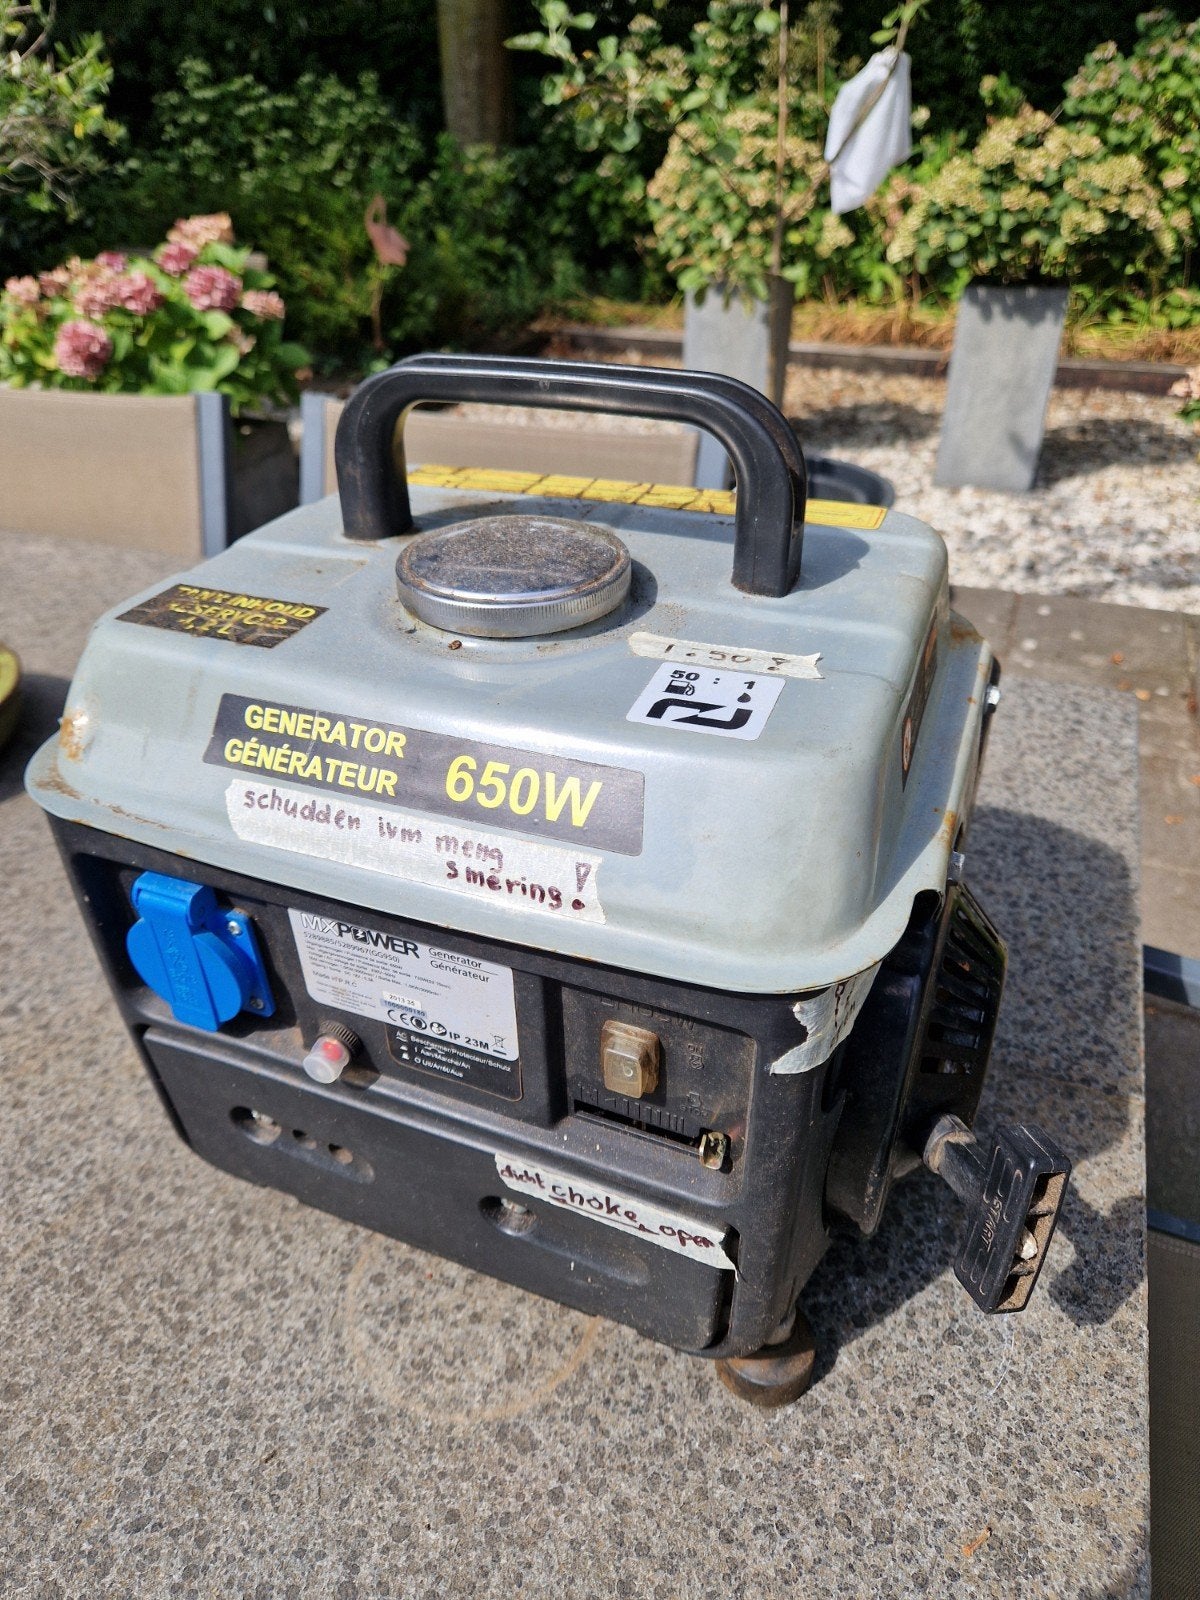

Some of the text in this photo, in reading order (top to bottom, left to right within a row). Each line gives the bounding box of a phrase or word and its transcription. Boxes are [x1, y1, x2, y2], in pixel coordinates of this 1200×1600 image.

[669, 670, 700, 682] 50
[743, 680, 756, 690] 1
[244, 704, 407, 759] GENERATOR
[224, 738, 398, 797] GÉNÉRATEUR
[445, 755, 602, 828] 650W
[243, 788, 360, 831] schudden
[428, 947, 482, 969] Generator
[430, 960, 490, 983] Générateur
[449, 1031, 461, 1041] IP
[465, 1037, 490, 1051] 23M
[552, 1186, 638, 1223] choke
[659, 1225, 716, 1248] open
[981, 1196, 1003, 1253] START
